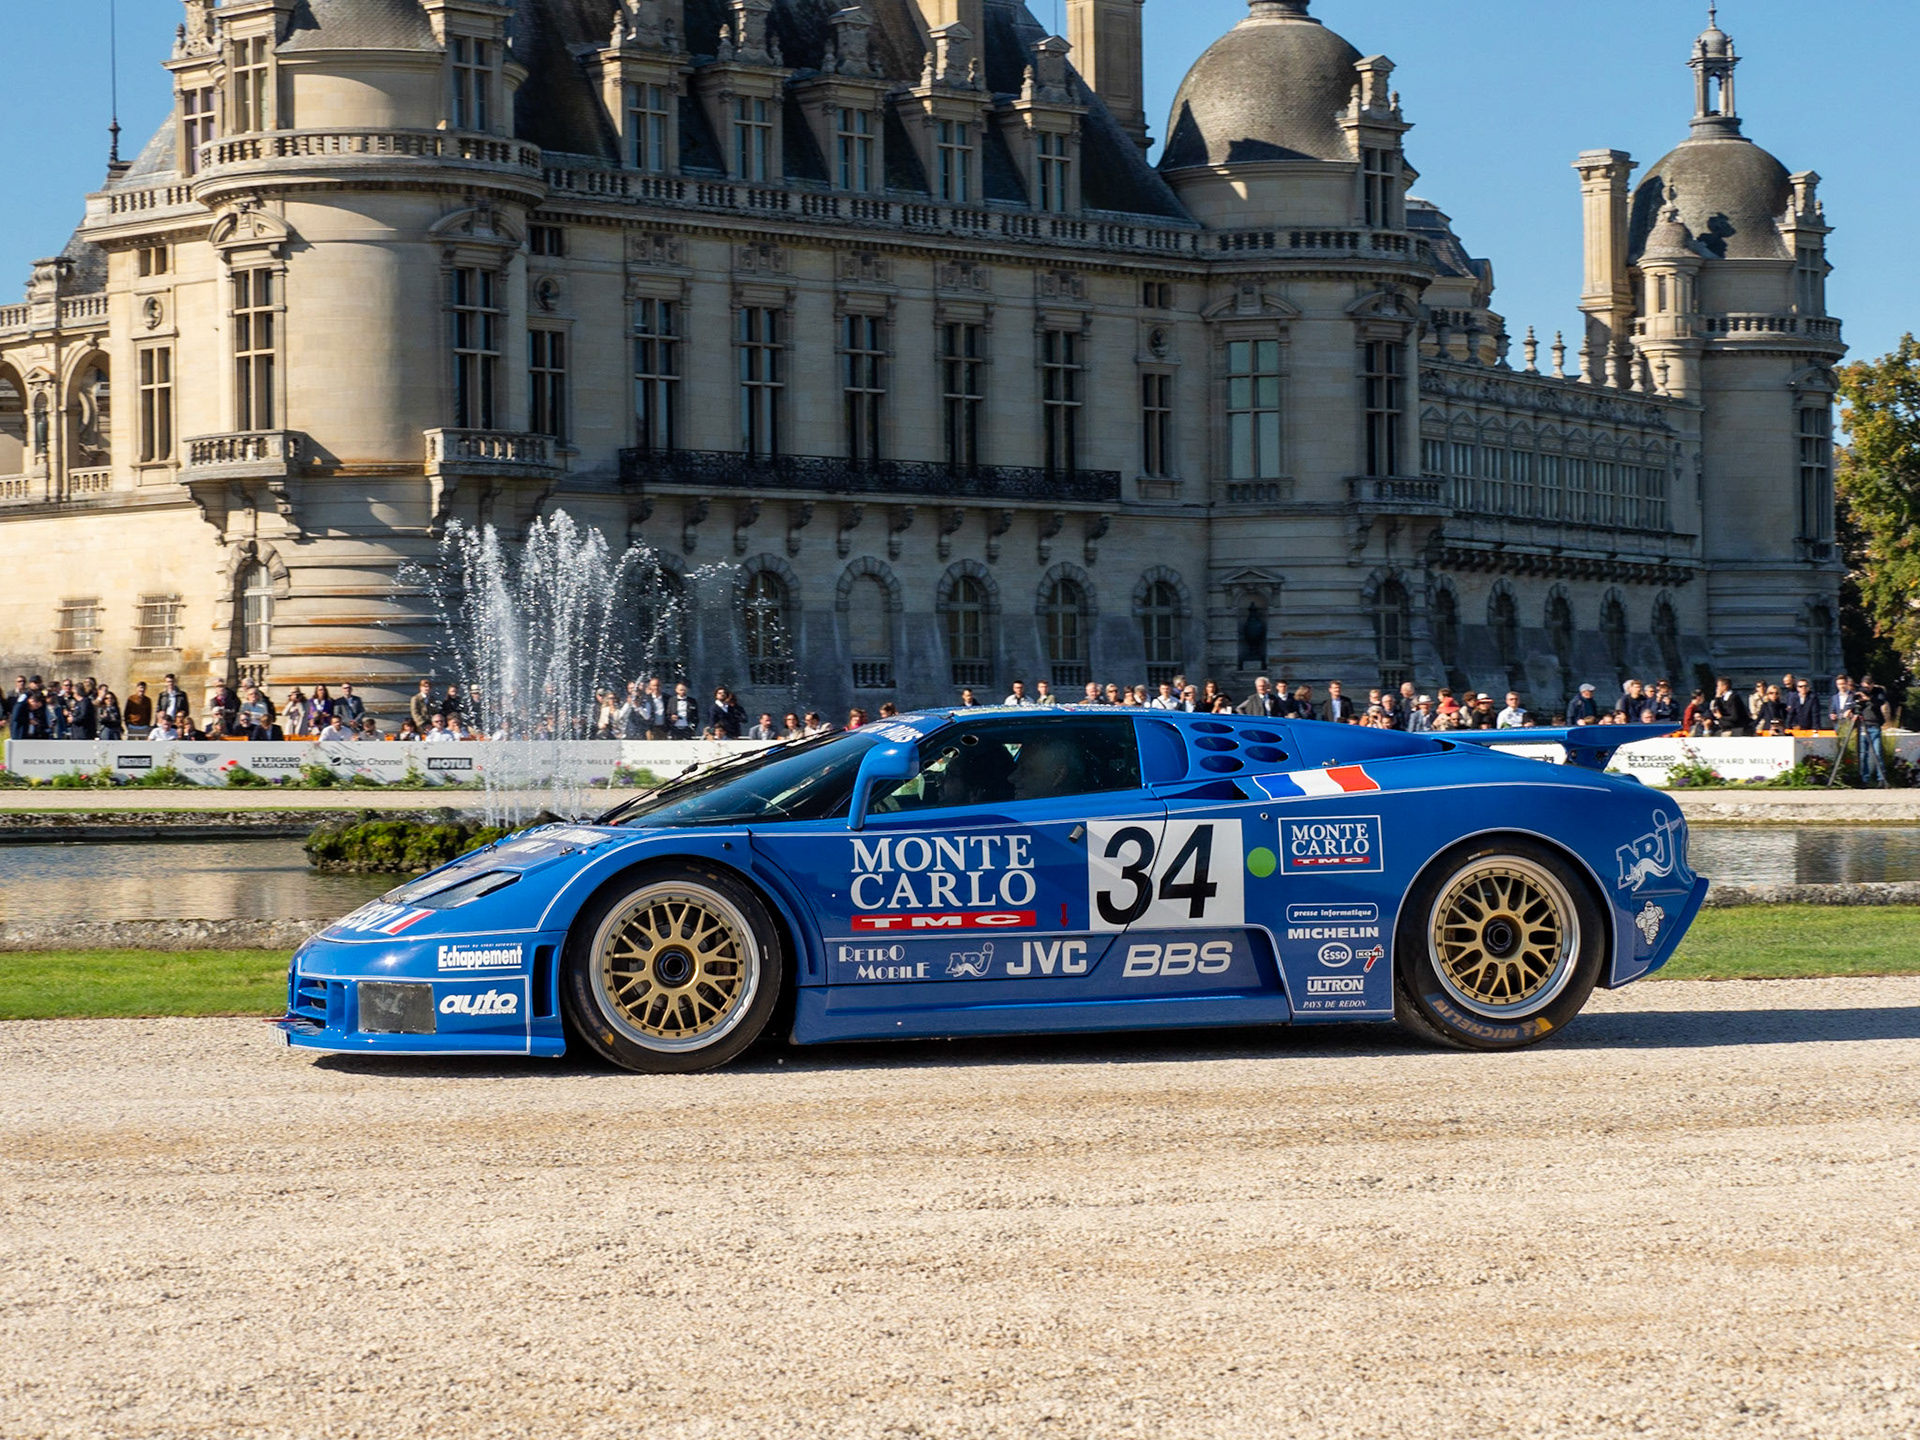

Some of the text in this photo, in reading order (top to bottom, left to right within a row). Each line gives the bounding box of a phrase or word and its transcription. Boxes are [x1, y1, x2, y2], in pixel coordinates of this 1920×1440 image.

[367, 757, 403, 766] Channel
[430, 758, 471, 768] MOTUL
[1291, 823, 1369, 840] MONTE
[849, 834, 1035, 873] MONTE
[1291, 838, 1370, 856] CARLO
[1096, 824, 1217, 925] 34
[850, 869, 1037, 910] CARLO
[860, 914, 1021, 928] TMC
[1320, 909, 1372, 917] informatique
[1287, 926, 1379, 939] MICHELIN
[438, 944, 523, 970] Echappement
[1006, 940, 1087, 975] JVC
[1122, 940, 1233, 978] BBS
[855, 961, 930, 980] MOBILE
[1307, 979, 1364, 992] ULTRON
[439, 989, 518, 1014] auto
[1303, 1000, 1322, 1008] PAYS
[1324, 1000, 1335, 1008] DE
[470, 1008, 517, 1016] passion
[1432, 998, 1518, 1039] MICHELIN
